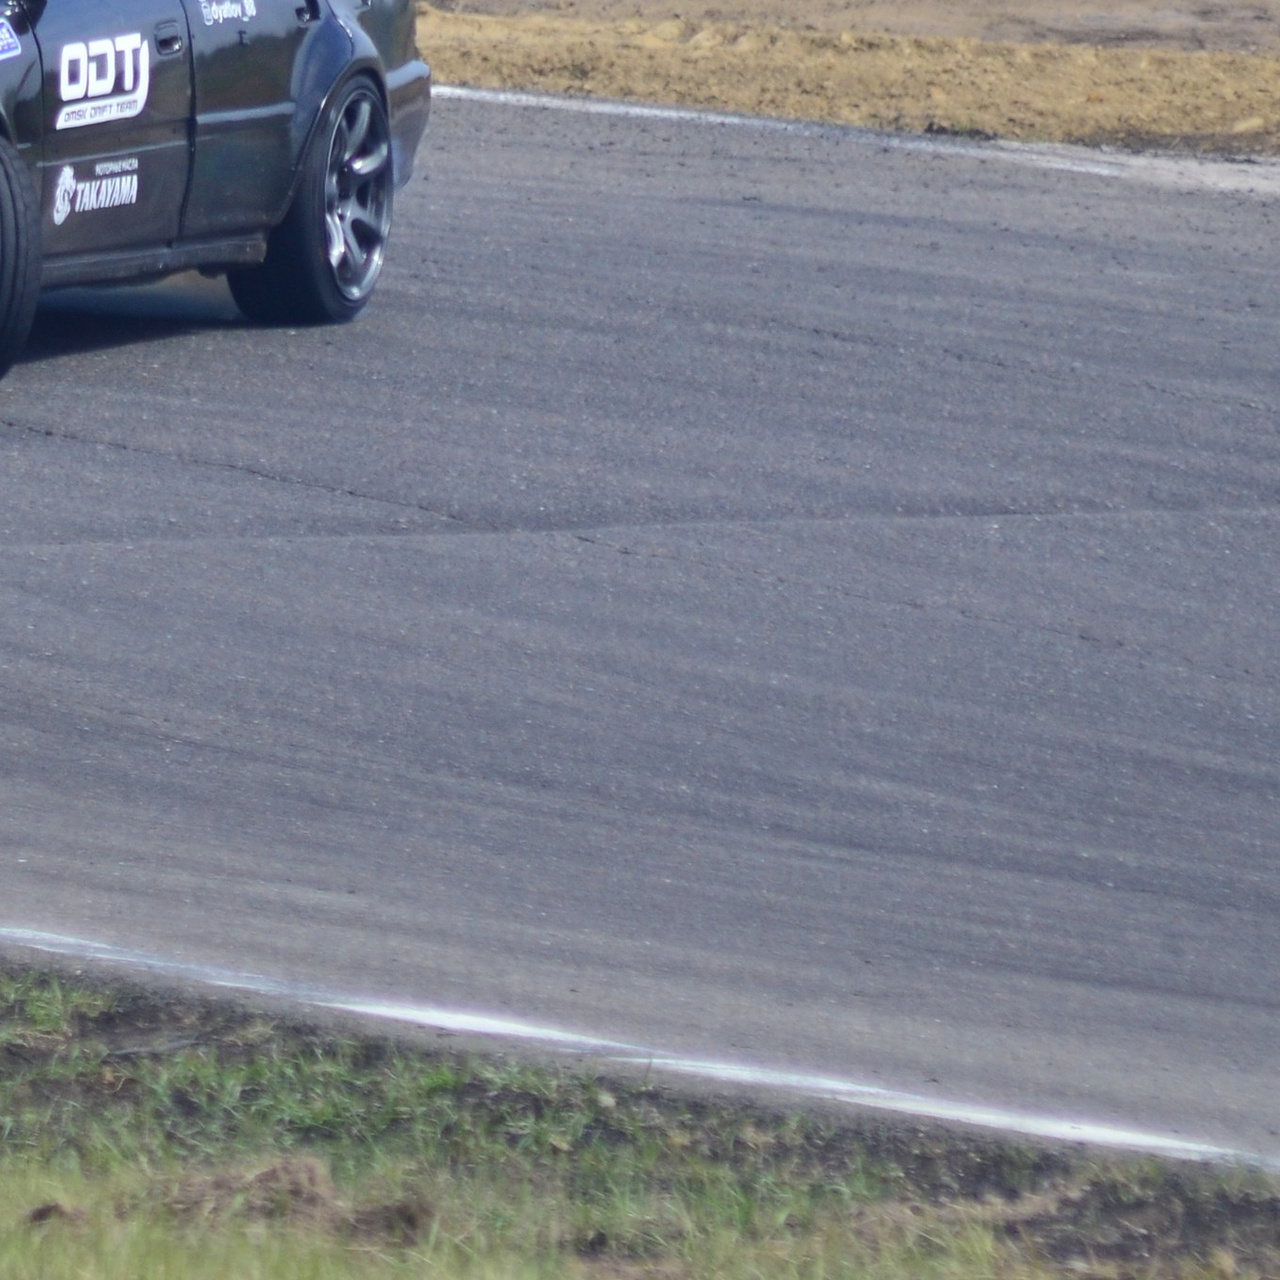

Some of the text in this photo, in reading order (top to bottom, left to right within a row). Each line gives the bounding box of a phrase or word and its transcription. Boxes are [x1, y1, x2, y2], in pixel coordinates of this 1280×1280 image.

[60, 32, 142, 102] ODT
[116, 100, 138, 114] TEAM
[75, 174, 139, 213] TAKAYAMA
